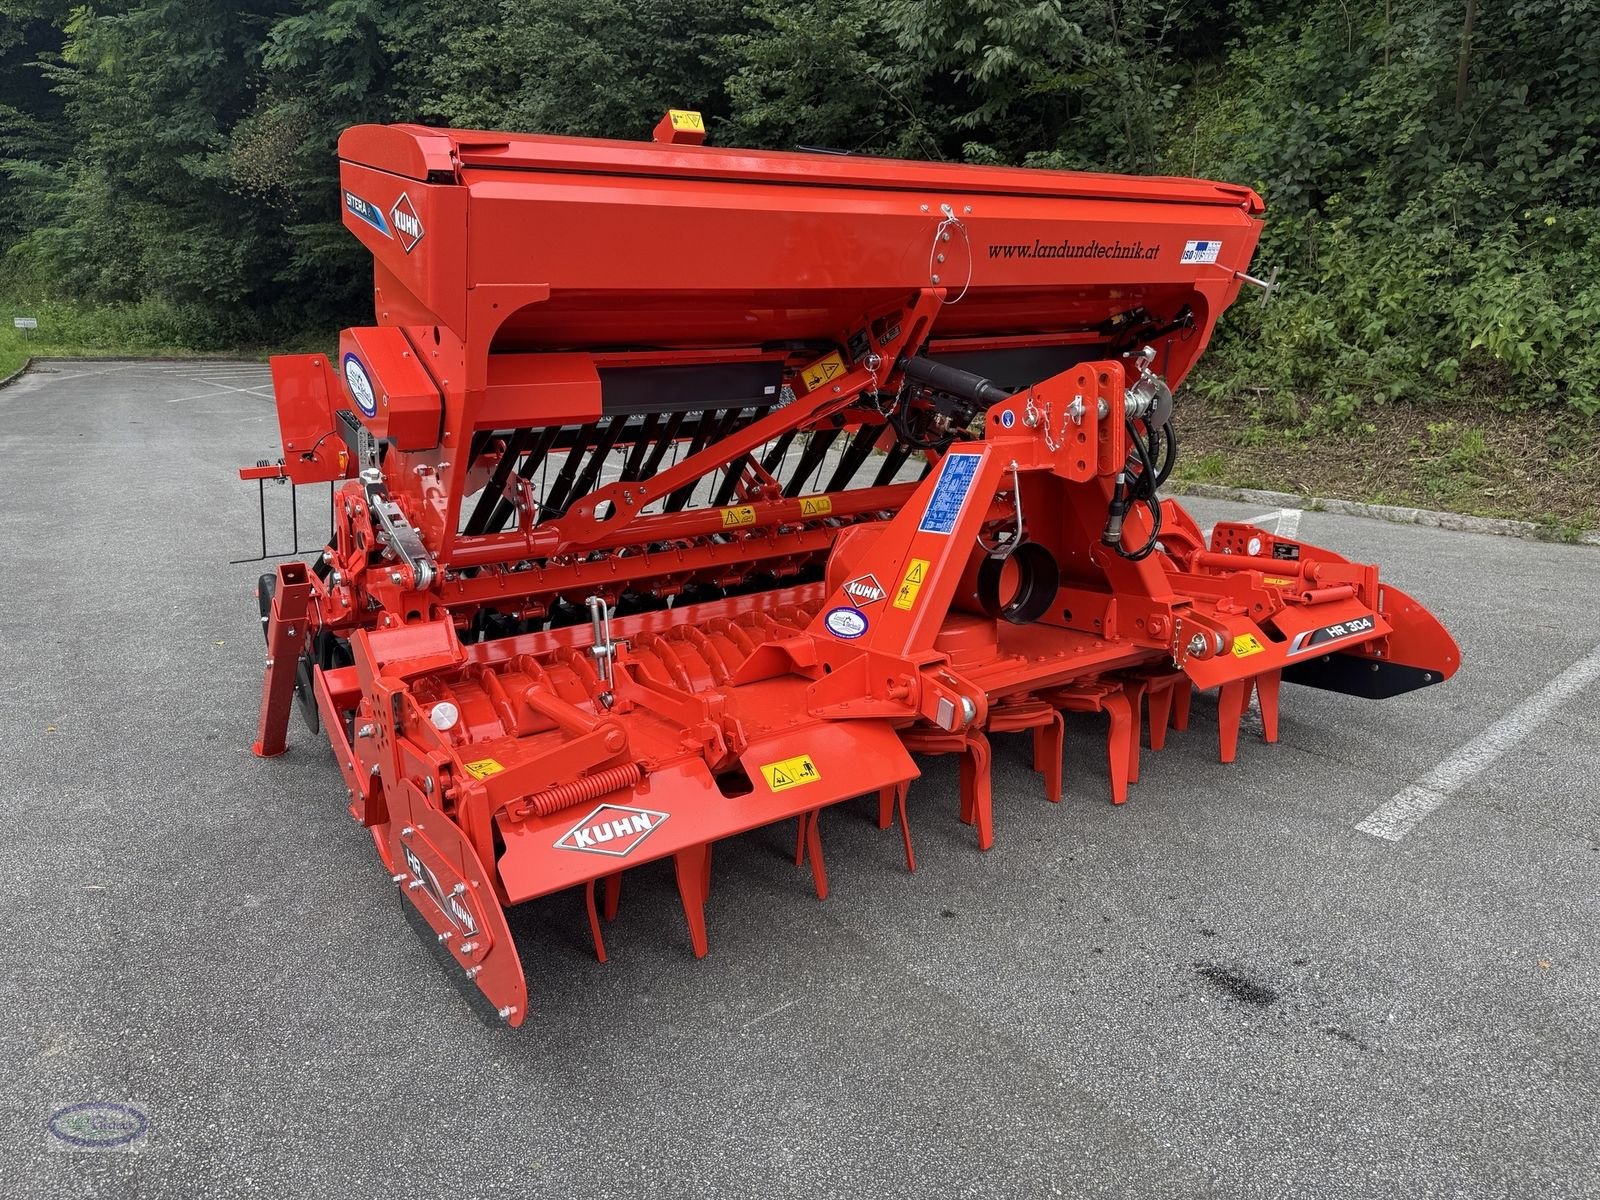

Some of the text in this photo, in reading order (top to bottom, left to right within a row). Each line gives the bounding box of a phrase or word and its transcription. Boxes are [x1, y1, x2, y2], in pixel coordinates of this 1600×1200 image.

[346, 192, 368, 216] SITERA
[394, 208, 419, 238] KUHN
[988, 239, 1160, 260] www.landundtechnik.at
[848, 582, 881, 600] KUHN
[1325, 618, 1372, 638] HR 304
[574, 812, 653, 849] KUHN
[406, 848, 422, 880] HR
[451, 897, 474, 932] KUHN
